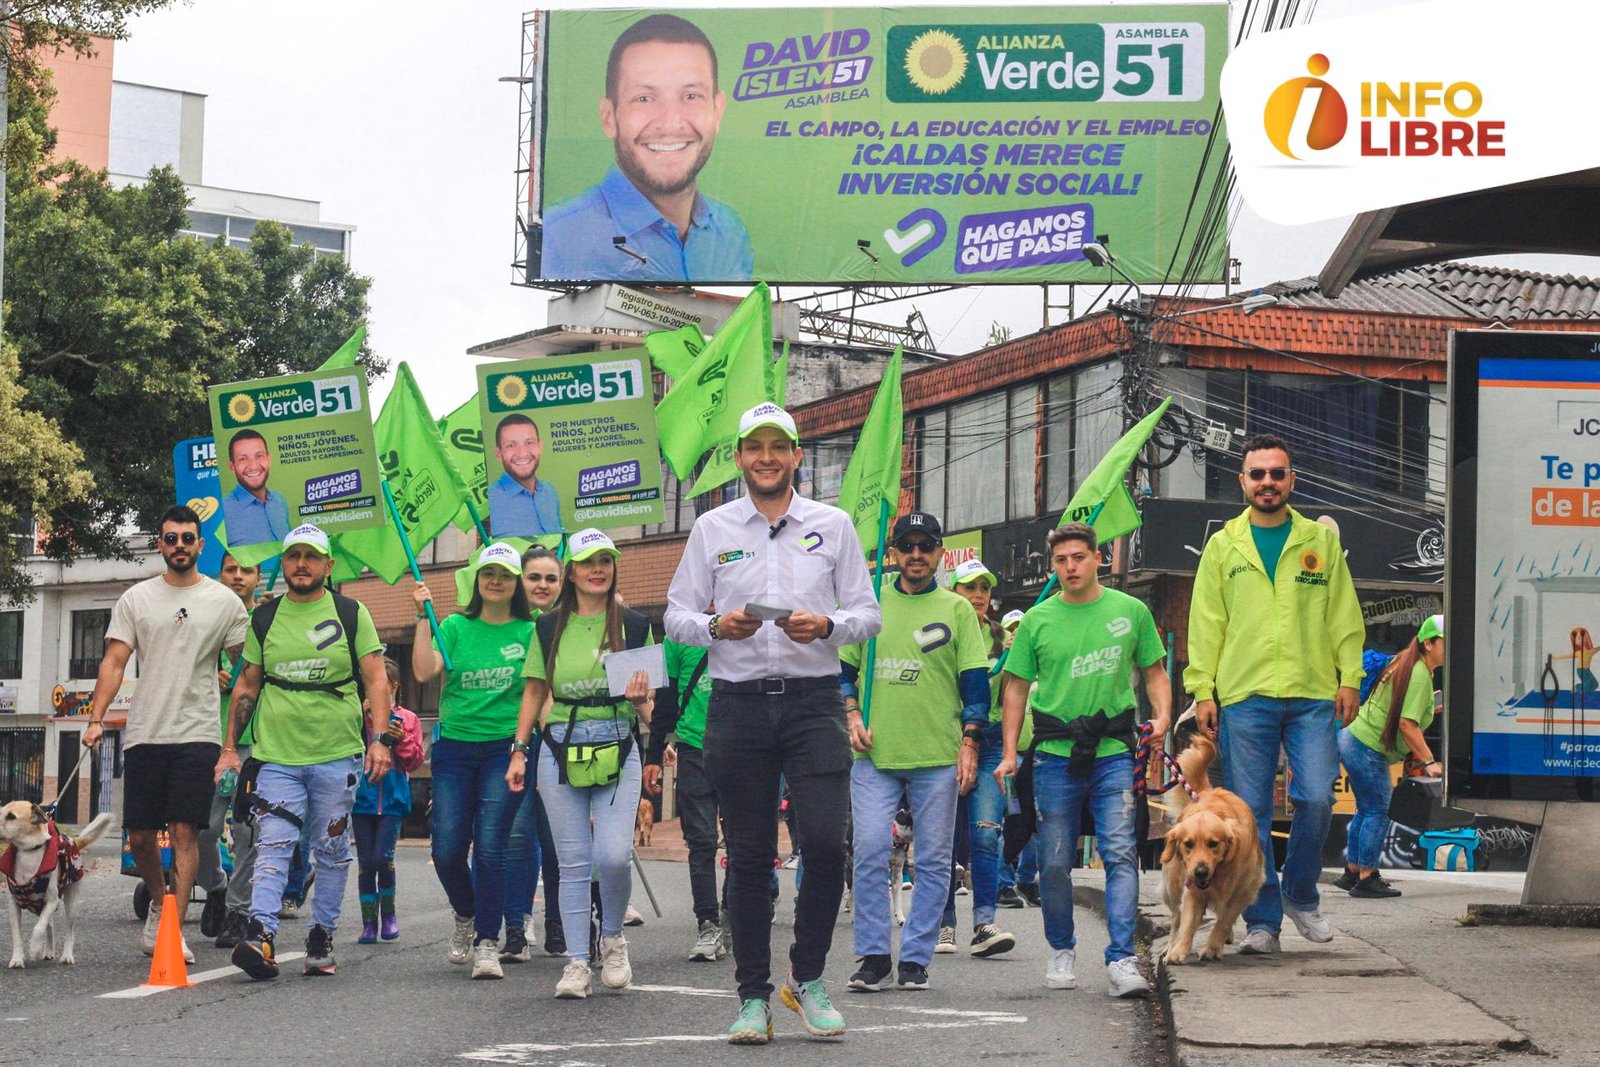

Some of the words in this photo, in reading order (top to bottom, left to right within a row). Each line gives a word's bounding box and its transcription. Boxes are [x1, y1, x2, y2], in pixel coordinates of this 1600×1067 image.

[976, 35, 1066, 50] ALIANZA
[1115, 28, 1189, 39] ASAMBLEA
[742, 28, 871, 70] DAVID
[976, 52, 1100, 90] Verde
[1112, 43, 1184, 97] 51
[784, 88, 870, 110] ASAMBLEA
[765, 121, 792, 137] EL
[798, 121, 885, 140] CAMPO,
[890, 121, 919, 137] LA
[925, 116, 1060, 137] EDUCACIÓN
[1066, 119, 1082, 136] Y
[1084, 119, 1112, 136] EL
[1118, 119, 1211, 136] EMPLEO
[852, 143, 990, 166] ¡CALDAS
[994, 143, 1126, 166] MERECE
[838, 167, 1011, 195] INVERSIÓN
[1015, 173, 1143, 196] SOCIAL!
[963, 211, 1086, 246] HAGAMOS
[961, 241, 1014, 265] QUE
[1018, 230, 1083, 258] PASE
[617, 289, 653, 308] Registro
[653, 303, 701, 323] publicitario
[620, 301, 686, 328] RPV-063-10-202
[531, 371, 574, 383] ALIANZA
[599, 370, 633, 398] 51
[258, 388, 298, 400] ALIANZA
[320, 385, 353, 413] 51
[531, 379, 593, 402] Verde
[259, 395, 315, 418] Verde
[550, 421, 568, 429] POR
[570, 416, 615, 427] NUESTROS
[551, 427, 587, 438] NIÑOS,
[589, 422, 639, 435] JÓVENES,
[277, 435, 293, 443] POR
[295, 429, 337, 440] NUESTROS
[278, 440, 311, 451] NIÑOS,
[313, 434, 359, 447] JÓVENES,
[552, 437, 586, 447] ADULTOS
[280, 449, 310, 459] ADULTOS
[552, 444, 586, 453] MUJERES
[280, 456, 311, 465] MUJERES
[1540, 455, 1574, 479] Te
[307, 472, 358, 493] HAGAMOS
[581, 463, 636, 484] HAGAMOS
[581, 480, 604, 492] QUE
[606, 472, 636, 487] PASE
[307, 488, 329, 501] QUE
[330, 481, 357, 495] PASE
[1535, 490, 1572, 517] de
[461, 666, 515, 681] DAVID
